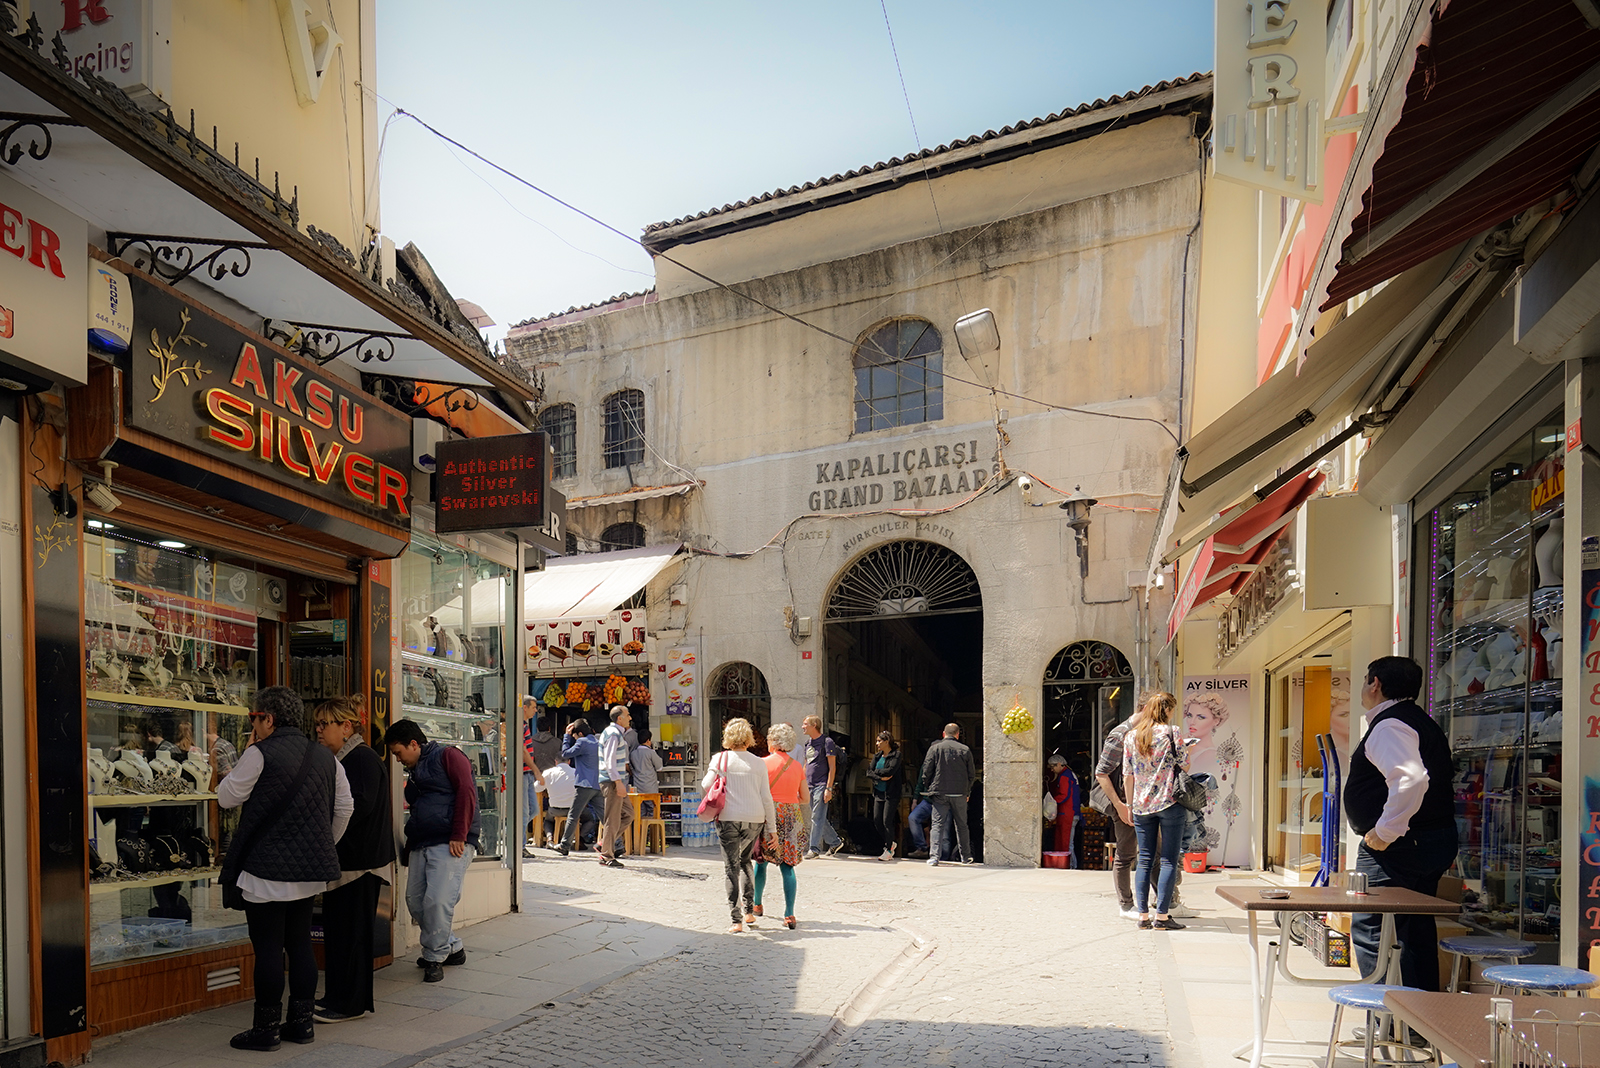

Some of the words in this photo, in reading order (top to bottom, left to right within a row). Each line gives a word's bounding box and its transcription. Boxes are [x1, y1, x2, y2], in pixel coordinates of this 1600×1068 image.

[47, 41, 134, 78] ercing
[109, 277, 119, 316] PRONET
[95, 312, 109, 323] 444
[117, 322, 130, 333] 911
[231, 341, 364, 445] AKSU
[1568, 427, 1576, 443] 24
[199, 387, 411, 518] SILVER
[816, 440, 978, 484] KAPALIÇARŞI
[443, 454, 537, 476] Authentic
[461, 475, 517, 492] Silver
[808, 480, 883, 511] GRAND
[894, 468, 989, 502] BAZAAR
[441, 489, 538, 511] Swarovski
[798, 531, 823, 541] GATE
[1186, 681, 1203, 691] AY
[1206, 678, 1248, 691] SİLVER
